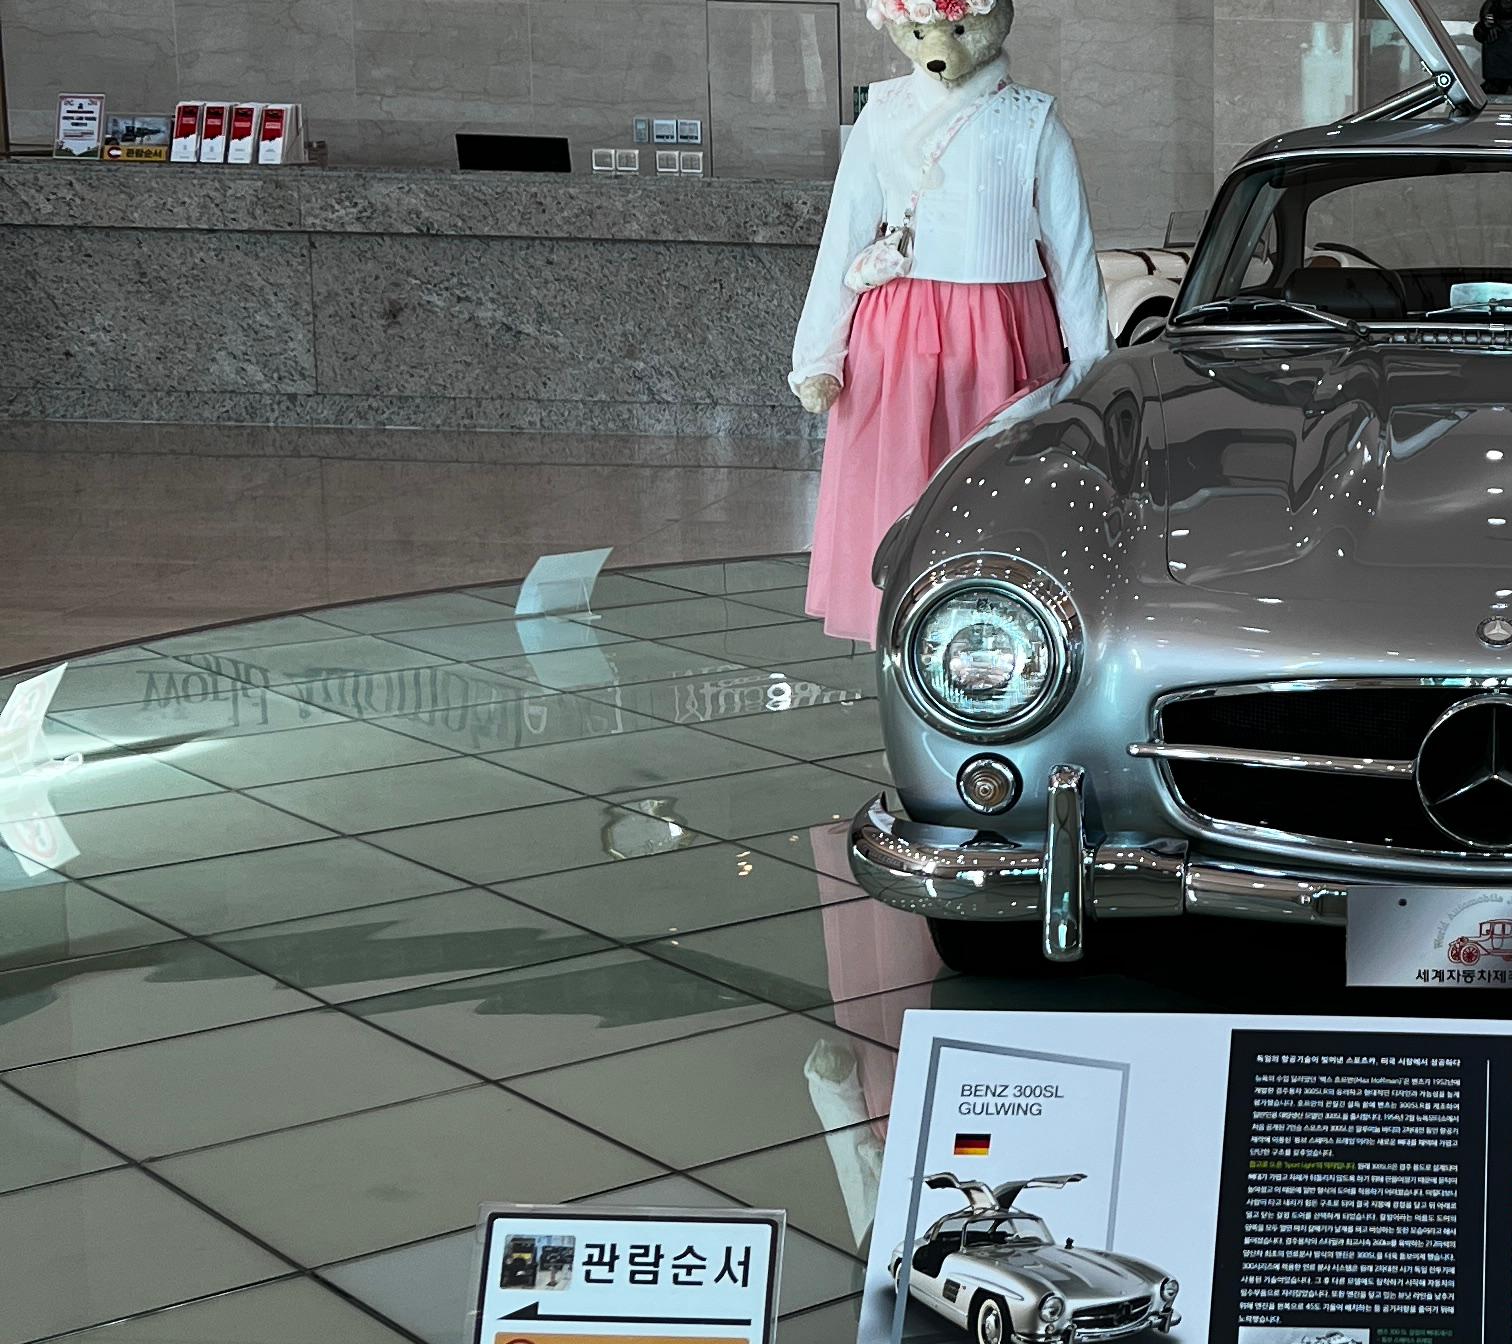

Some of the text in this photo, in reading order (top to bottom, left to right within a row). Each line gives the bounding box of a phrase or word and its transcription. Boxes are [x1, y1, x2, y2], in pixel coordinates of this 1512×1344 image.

[960, 1084, 1064, 1099] BENZ 300SL
[958, 1102, 1043, 1116] GULWING
[582, 1242, 751, 1288] 관람순서
